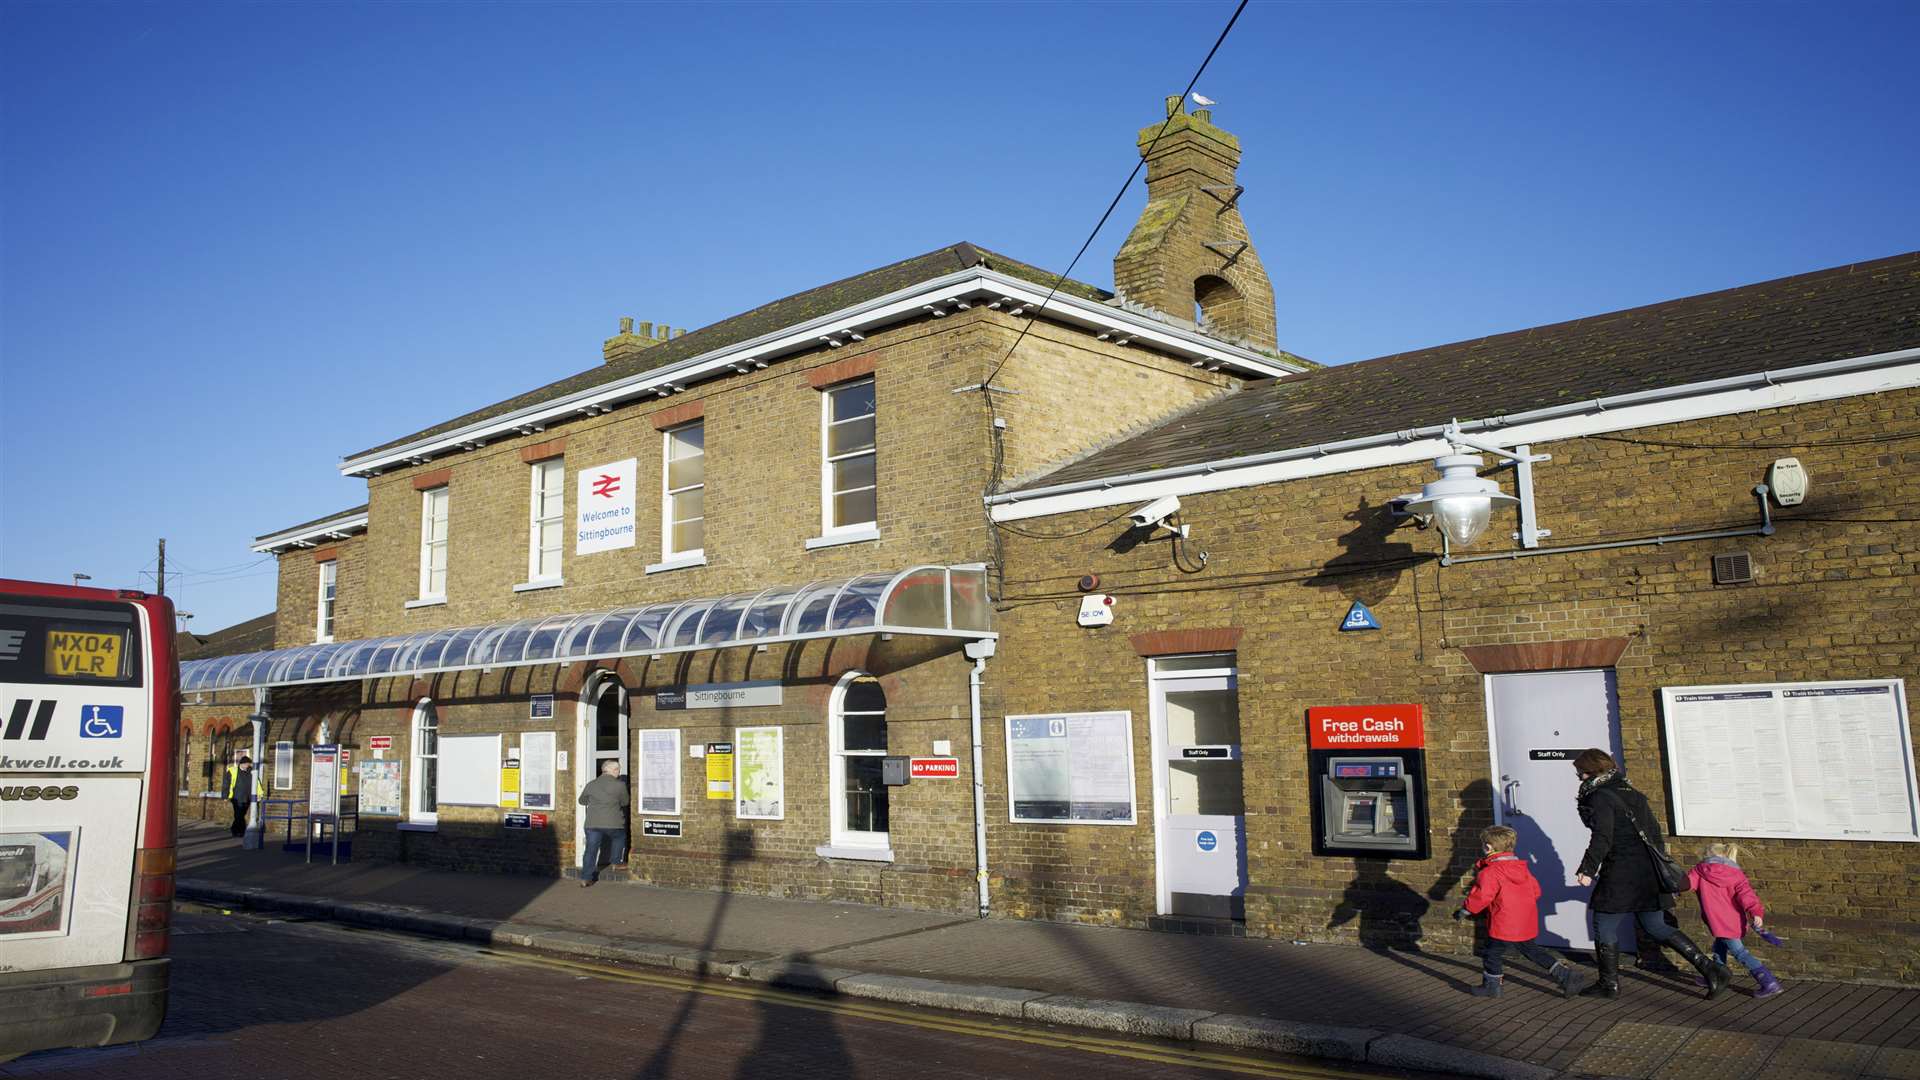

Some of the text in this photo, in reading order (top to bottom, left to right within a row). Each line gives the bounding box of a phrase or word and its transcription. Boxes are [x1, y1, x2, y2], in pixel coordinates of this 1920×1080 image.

[582, 506, 631, 522] Welcome to
[579, 524, 633, 541] Sittingbourne
[53, 634, 114, 653] MX04
[60, 654, 105, 672] VLR
[695, 690, 745, 703] Sittingbourne
[0, 699, 57, 740] ll
[1322, 717, 1404, 732] Free Cash
[1327, 732, 1399, 743] withdrawals
[0, 755, 123, 769] kwell.co.uk
[0, 786, 79, 801] uses
